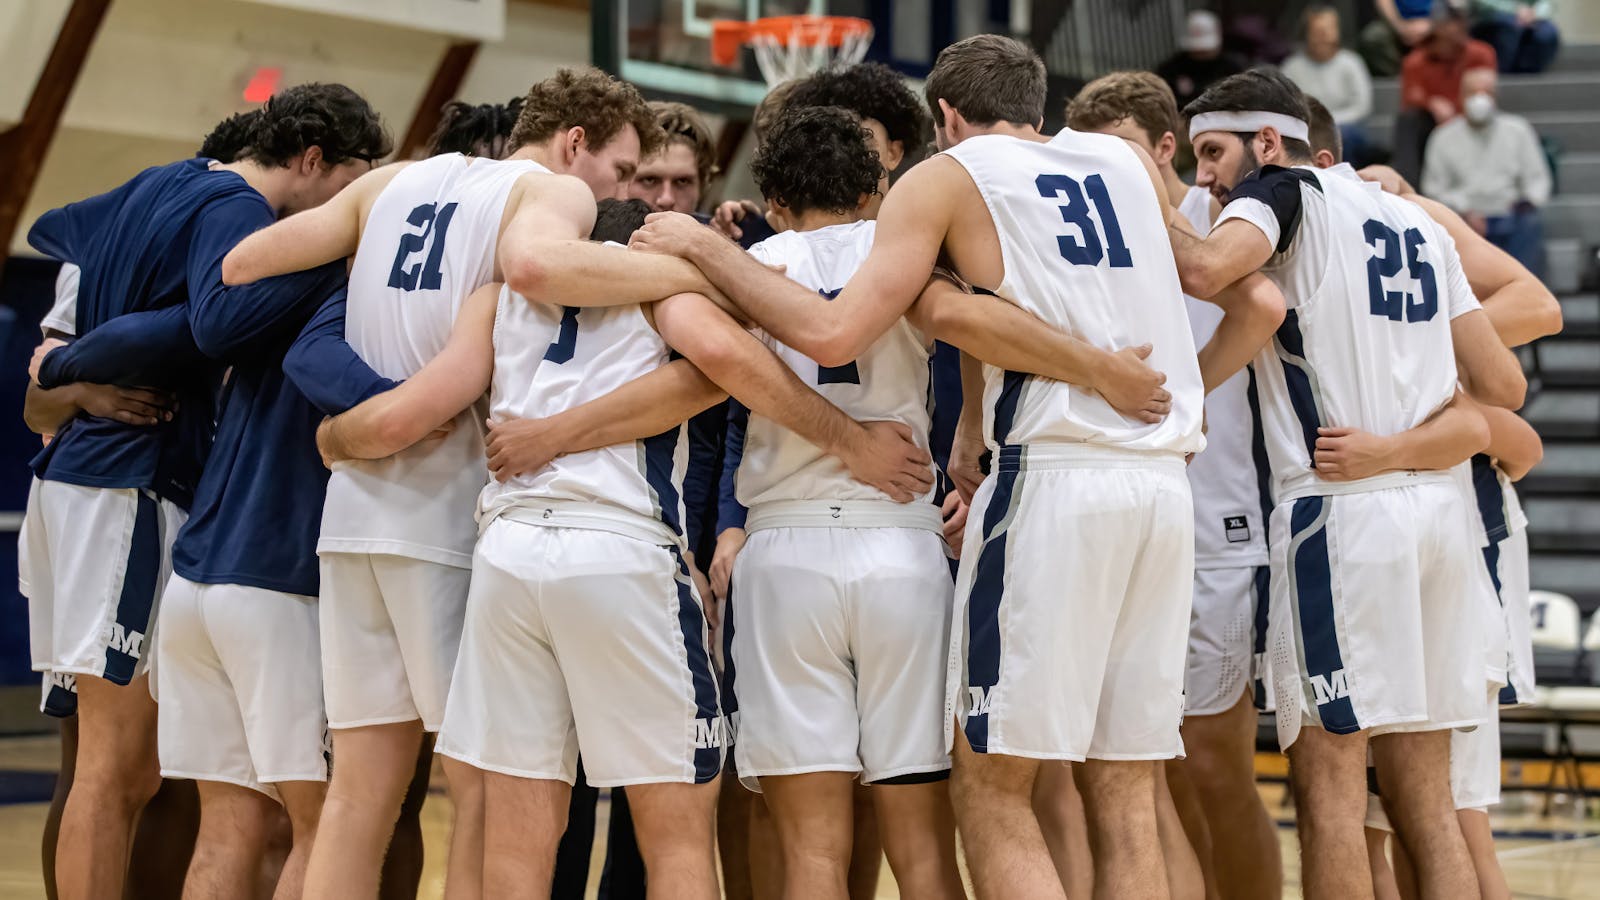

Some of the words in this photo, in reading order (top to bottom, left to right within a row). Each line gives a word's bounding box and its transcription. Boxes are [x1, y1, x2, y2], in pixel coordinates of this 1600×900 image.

[1035, 174, 1133, 267] 31
[387, 201, 459, 292] 21
[1362, 219, 1438, 323] 25
[1229, 519, 1244, 528] XL
[108, 622, 145, 659] M
[968, 686, 992, 716] M
[1309, 668, 1349, 706] M
[695, 717, 720, 748] M
